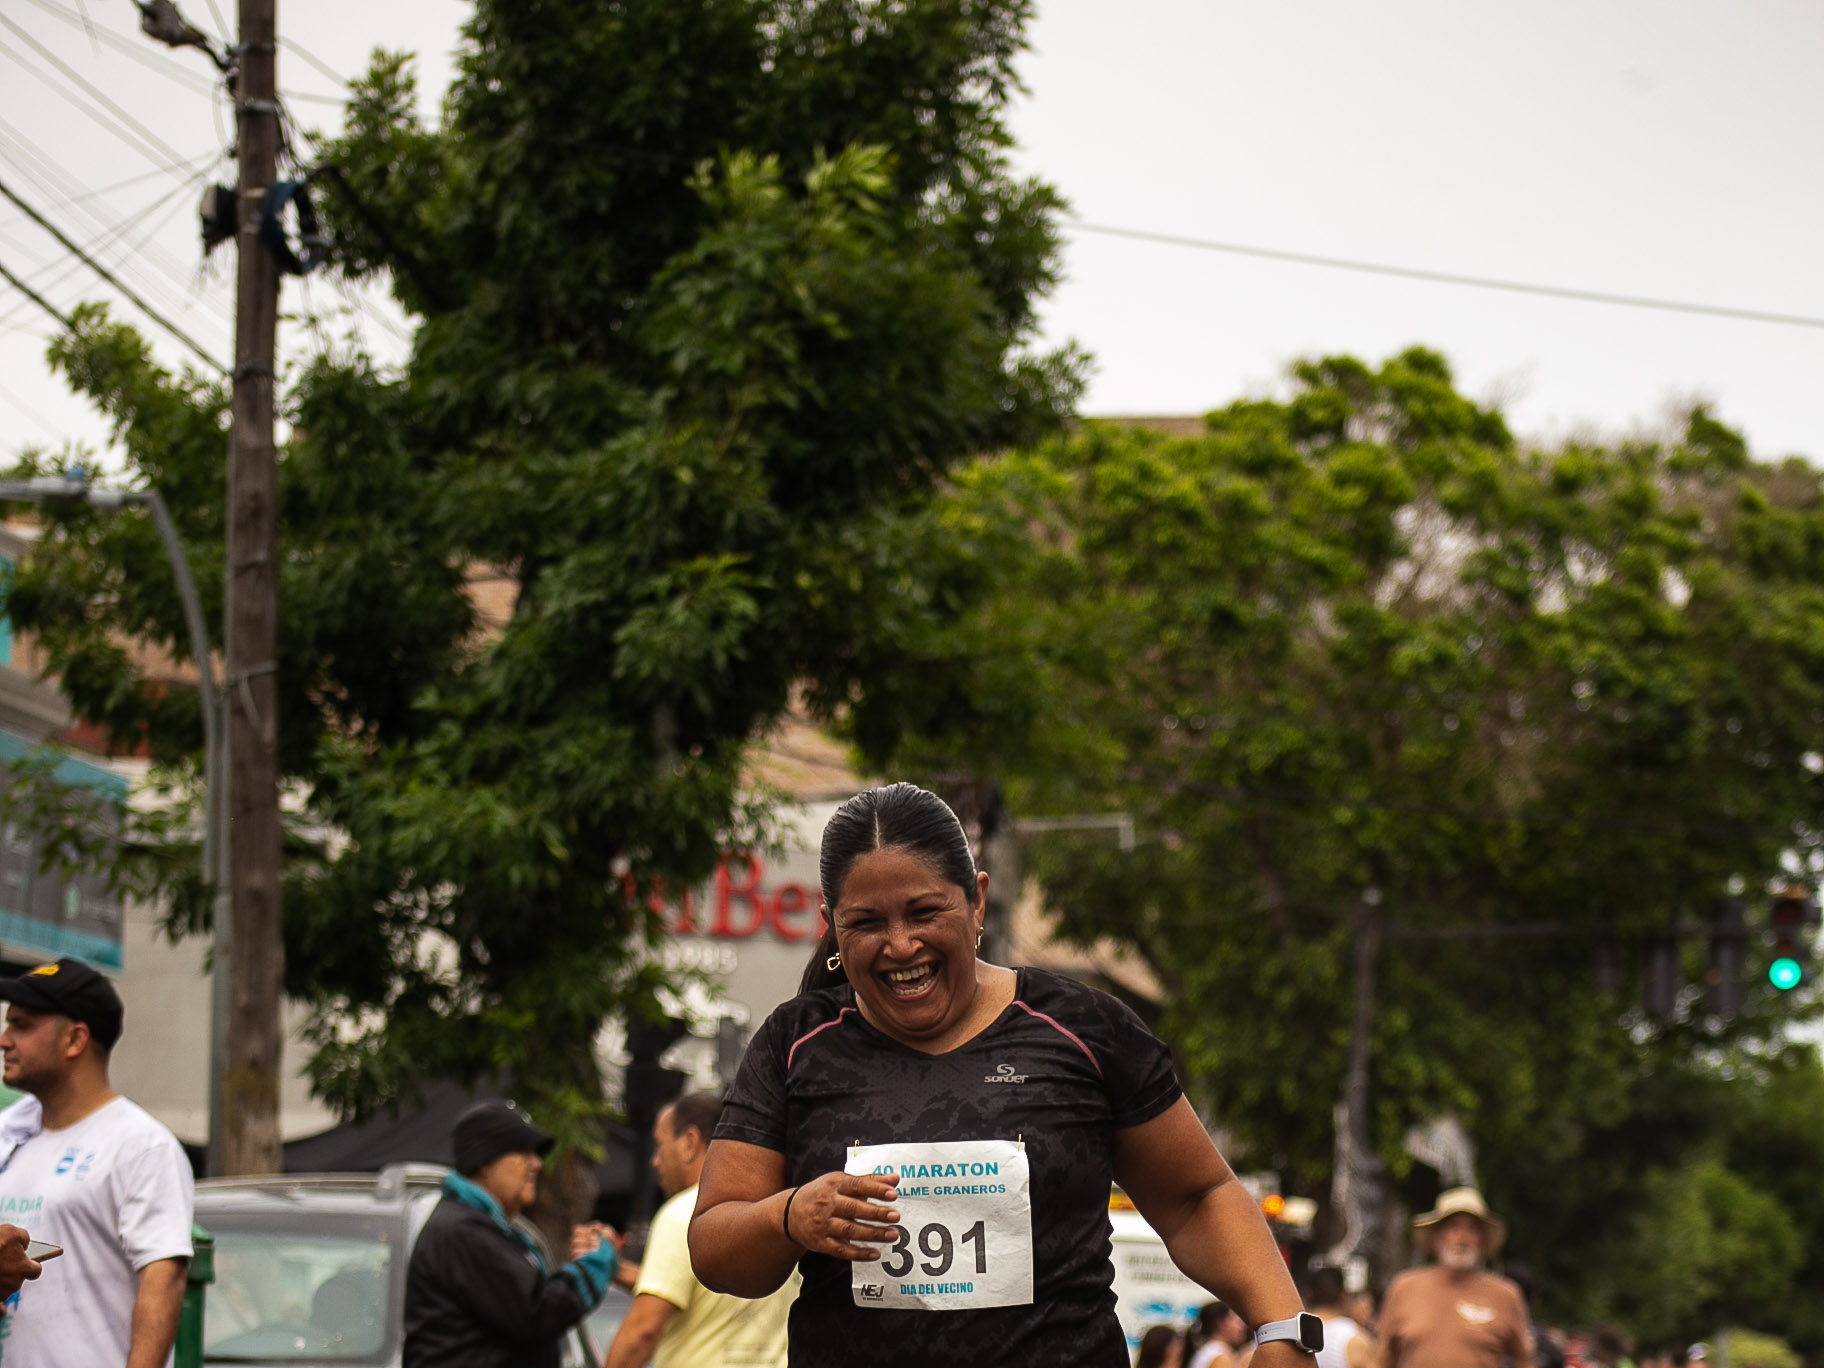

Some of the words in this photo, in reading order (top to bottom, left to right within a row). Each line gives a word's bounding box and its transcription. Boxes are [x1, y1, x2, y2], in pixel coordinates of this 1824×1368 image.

[872, 1165, 894, 1176] 40
[900, 1162, 999, 1178] MARATON
[933, 1184, 1006, 1196] GRANEROS
[880, 1220, 987, 1278] 391
[861, 1283, 884, 1297] NEJ
[900, 1284, 917, 1295] DIA
[919, 1283, 936, 1294] DEL
[937, 1281, 974, 1294] VECINO
